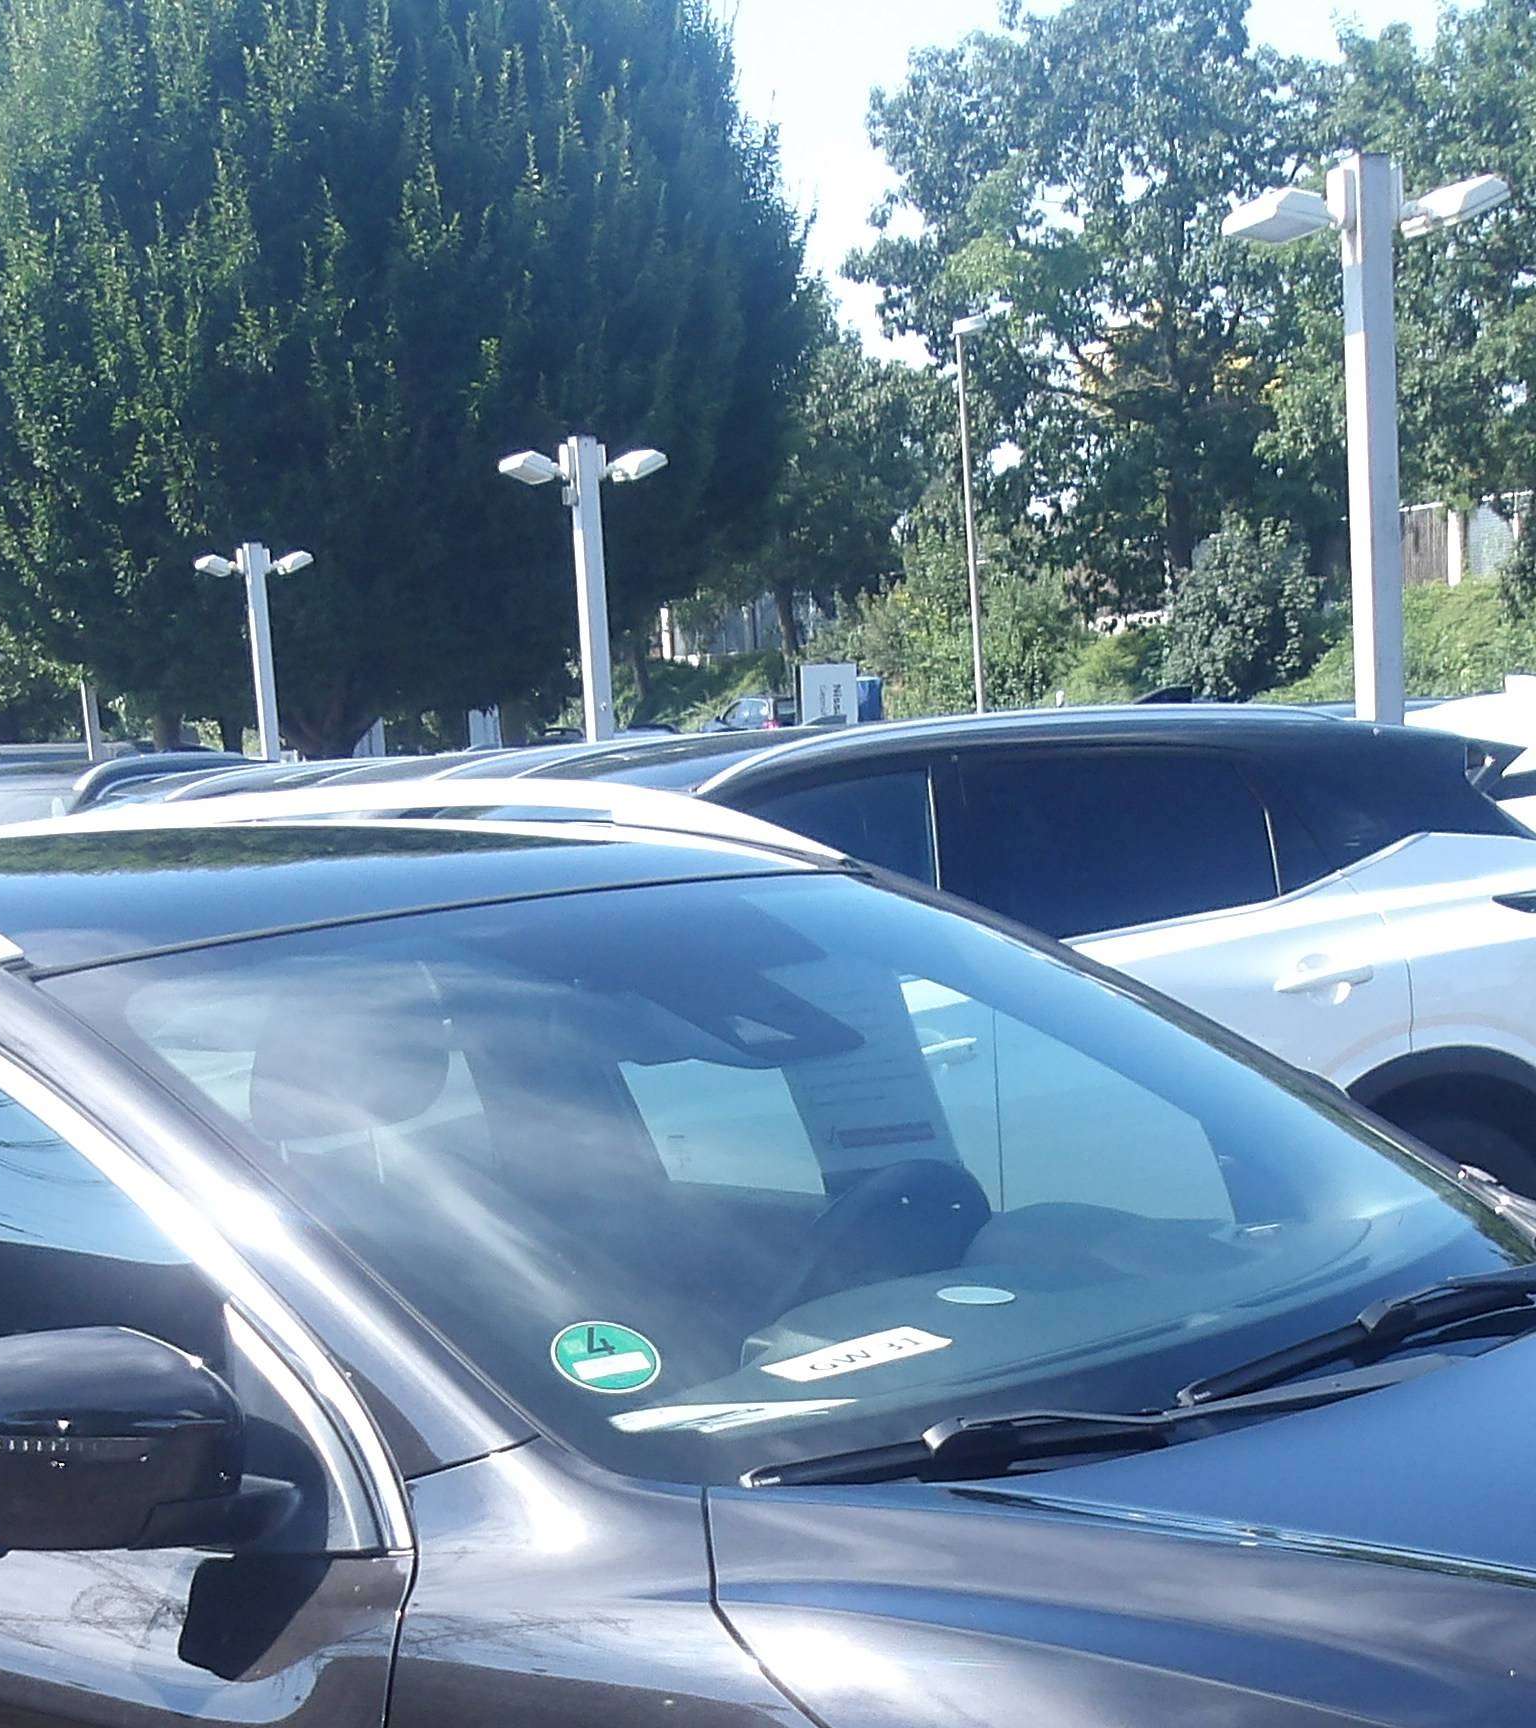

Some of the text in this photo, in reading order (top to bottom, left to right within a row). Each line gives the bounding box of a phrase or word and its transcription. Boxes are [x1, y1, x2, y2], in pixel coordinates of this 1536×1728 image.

[587, 1327, 616, 1355] 4
[808, 1336, 923, 1372] GW 31
